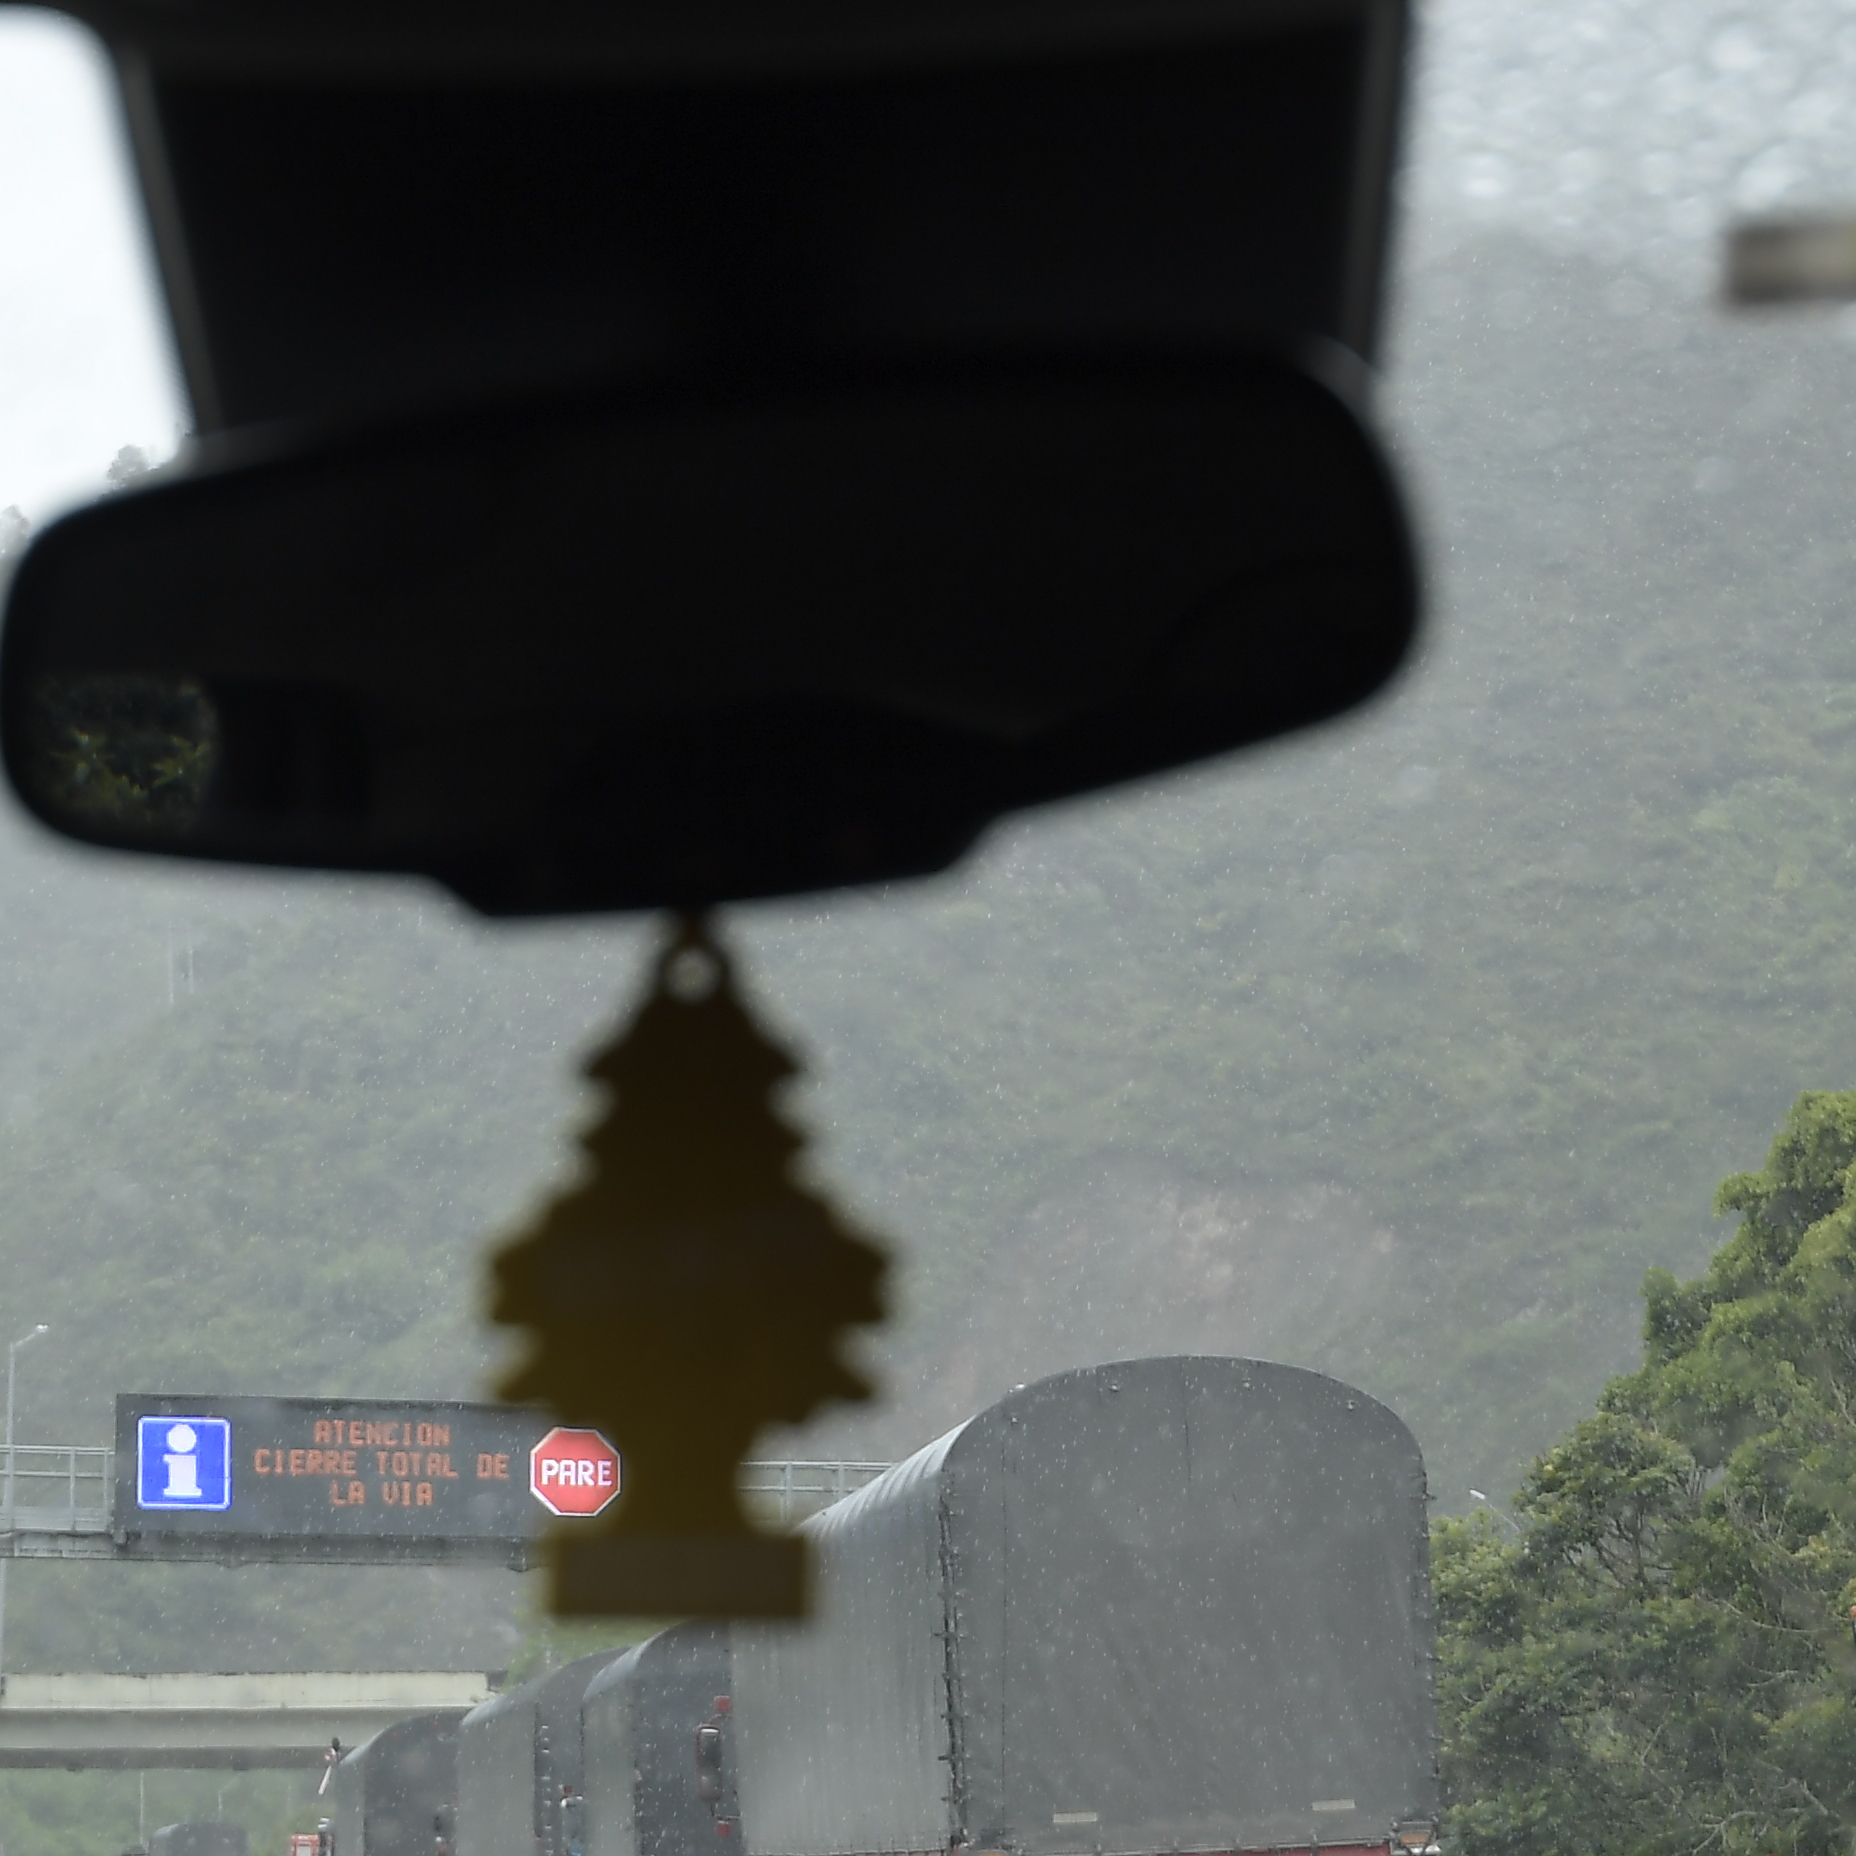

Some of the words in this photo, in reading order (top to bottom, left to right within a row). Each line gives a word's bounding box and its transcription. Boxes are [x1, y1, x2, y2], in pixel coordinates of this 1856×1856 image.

[314, 1418, 451, 1446] ATENCION
[253, 1448, 357, 1475] CIERRE
[376, 1451, 458, 1478] TOTAL
[476, 1453, 510, 1480] DE
[541, 1458, 612, 1486] PARE
[330, 1480, 365, 1506] LA
[382, 1480, 434, 1506] VIA
